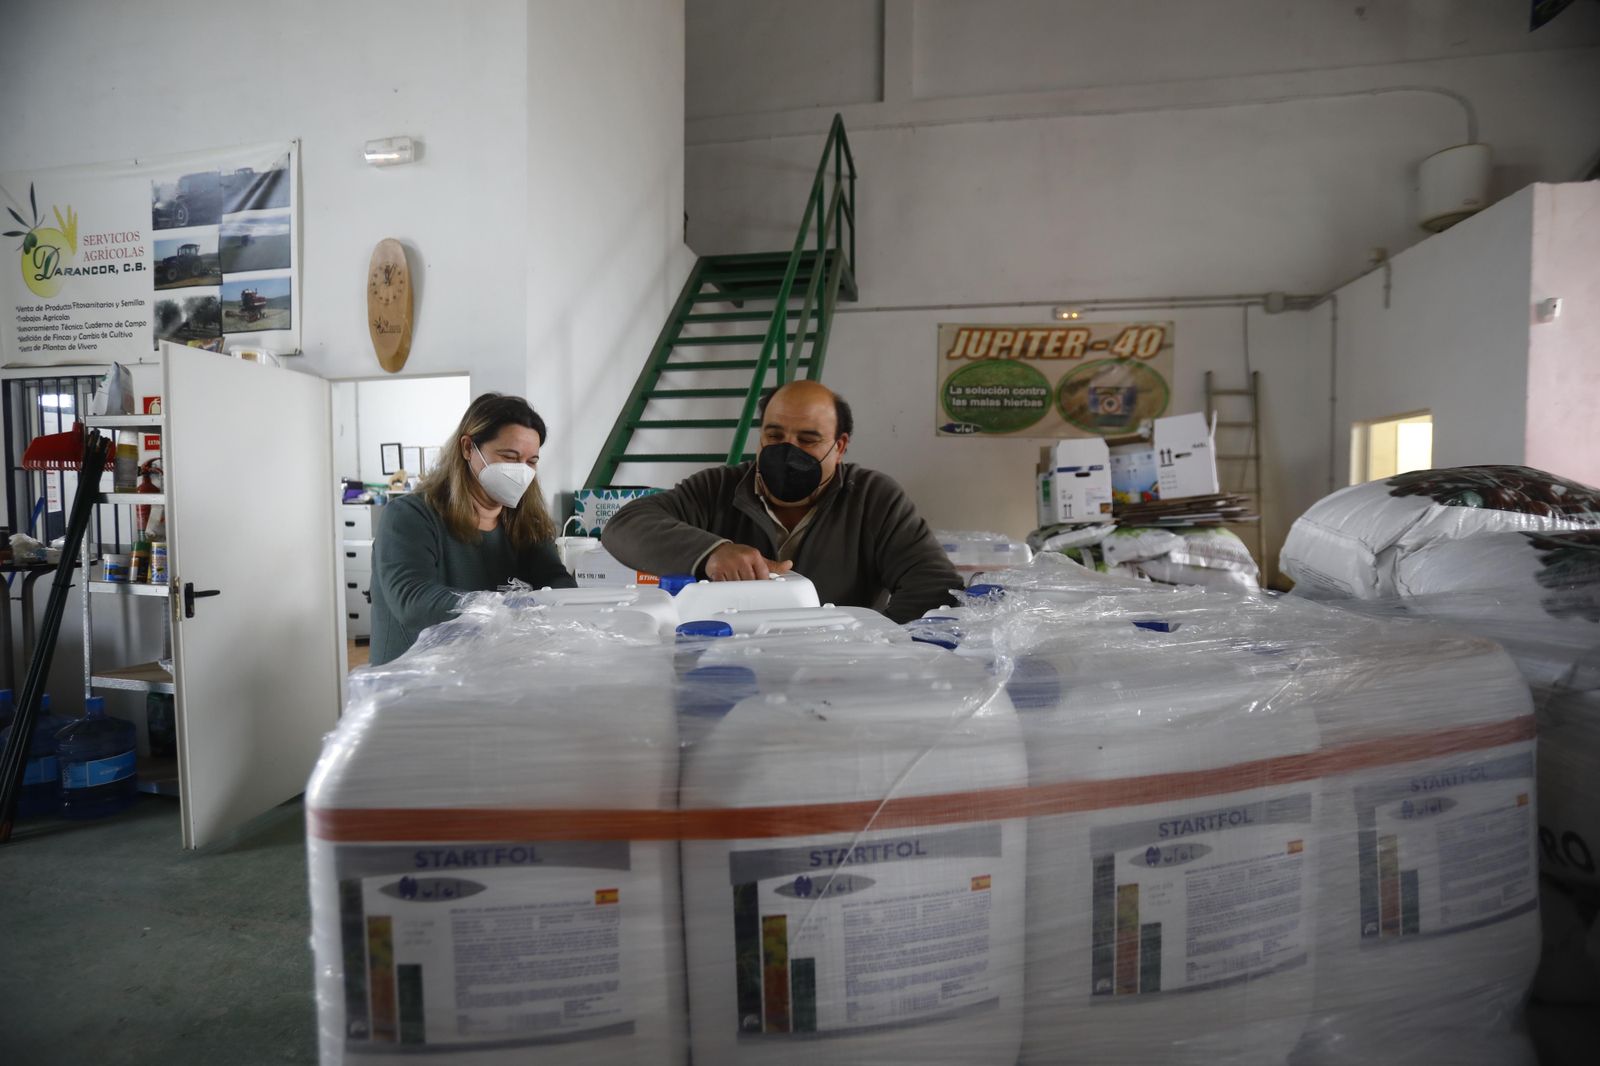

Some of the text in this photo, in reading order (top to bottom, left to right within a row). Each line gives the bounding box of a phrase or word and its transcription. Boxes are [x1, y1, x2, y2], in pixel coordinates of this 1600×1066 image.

[83, 231, 140, 246] SERVICIOS
[84, 246, 144, 262] AGRÍCOLAS
[123, 262, 146, 272] C.B.
[115, 320, 123, 328] de
[124, 320, 147, 328] Campo
[109, 330, 133, 338] Cultivo
[1159, 810, 1254, 838] STARTFOL
[414, 846, 543, 869] STARTFOL
[809, 840, 927, 867] STARTFOL
